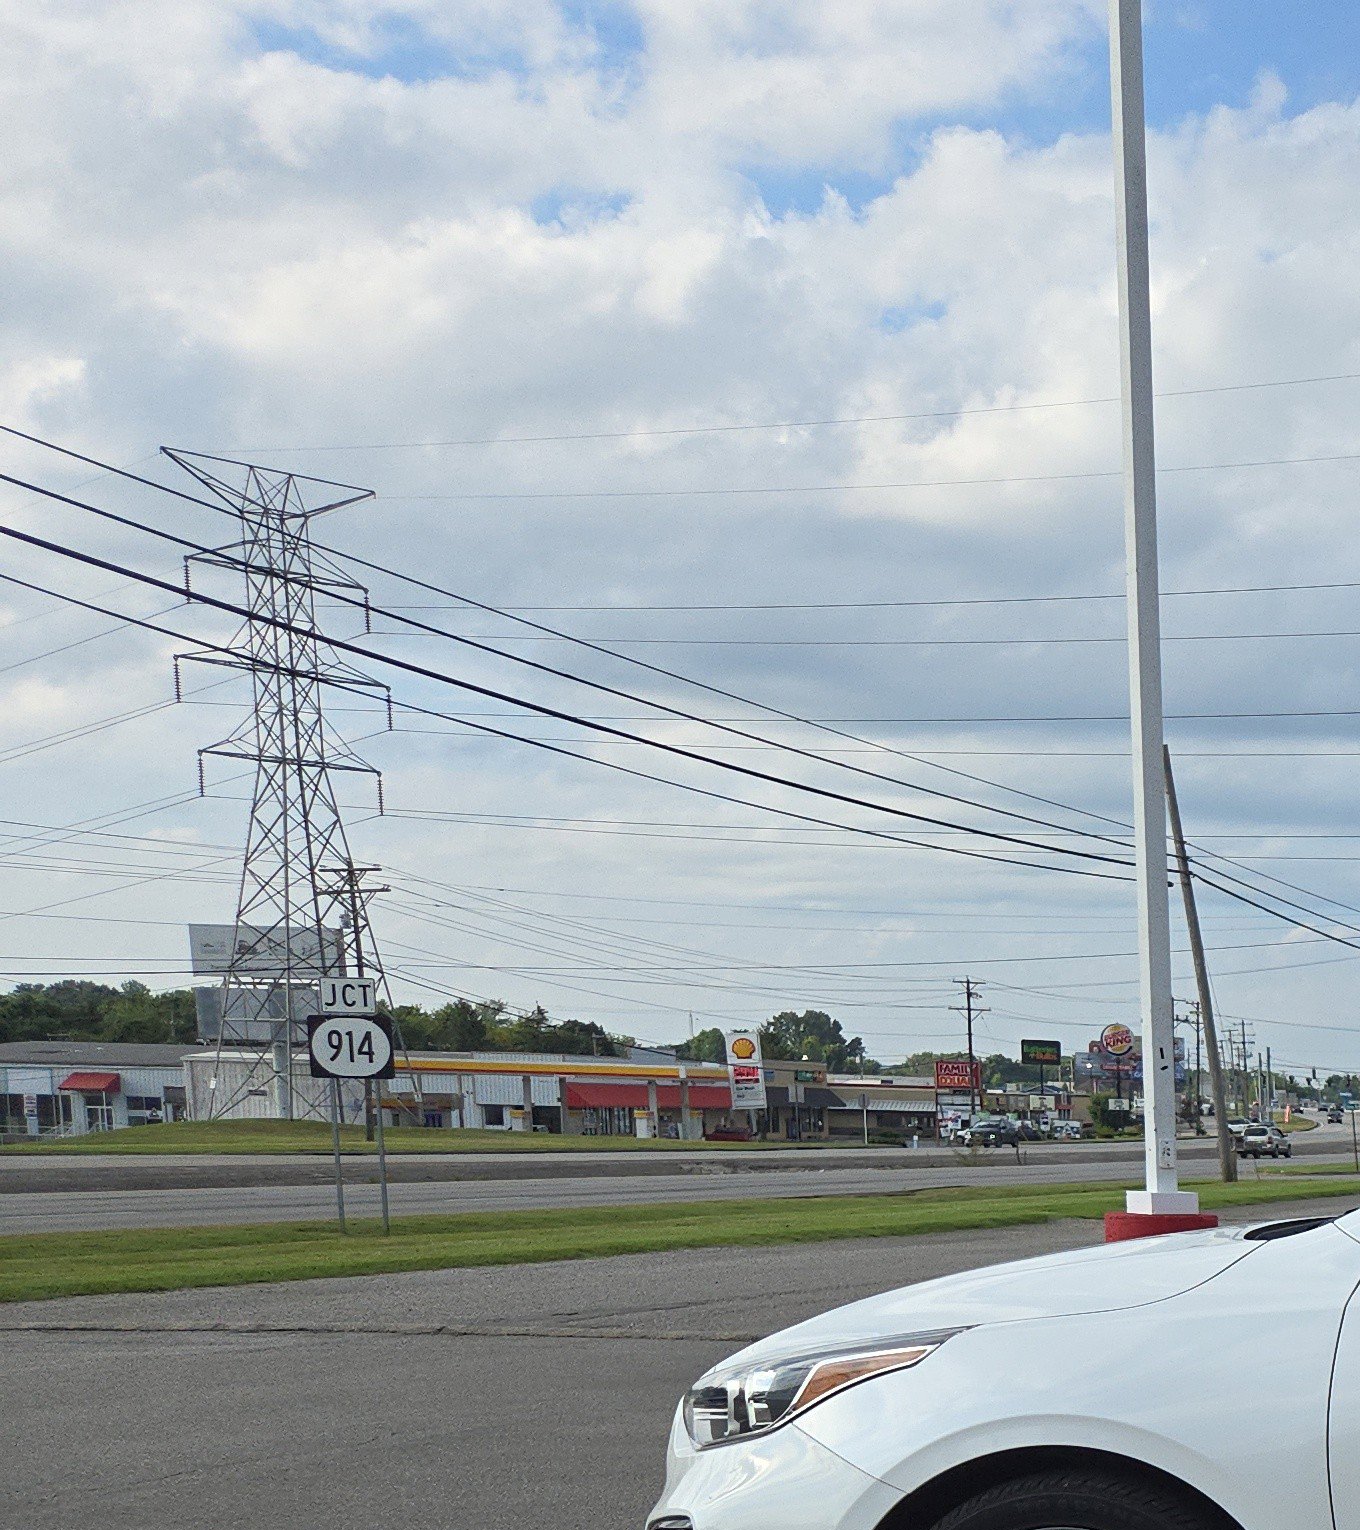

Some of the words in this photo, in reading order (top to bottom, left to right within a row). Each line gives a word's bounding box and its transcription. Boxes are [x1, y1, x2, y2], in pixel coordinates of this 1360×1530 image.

[324, 983, 372, 1008] JCT
[327, 1029, 375, 1063] 914
[1105, 1035, 1132, 1048] KING
